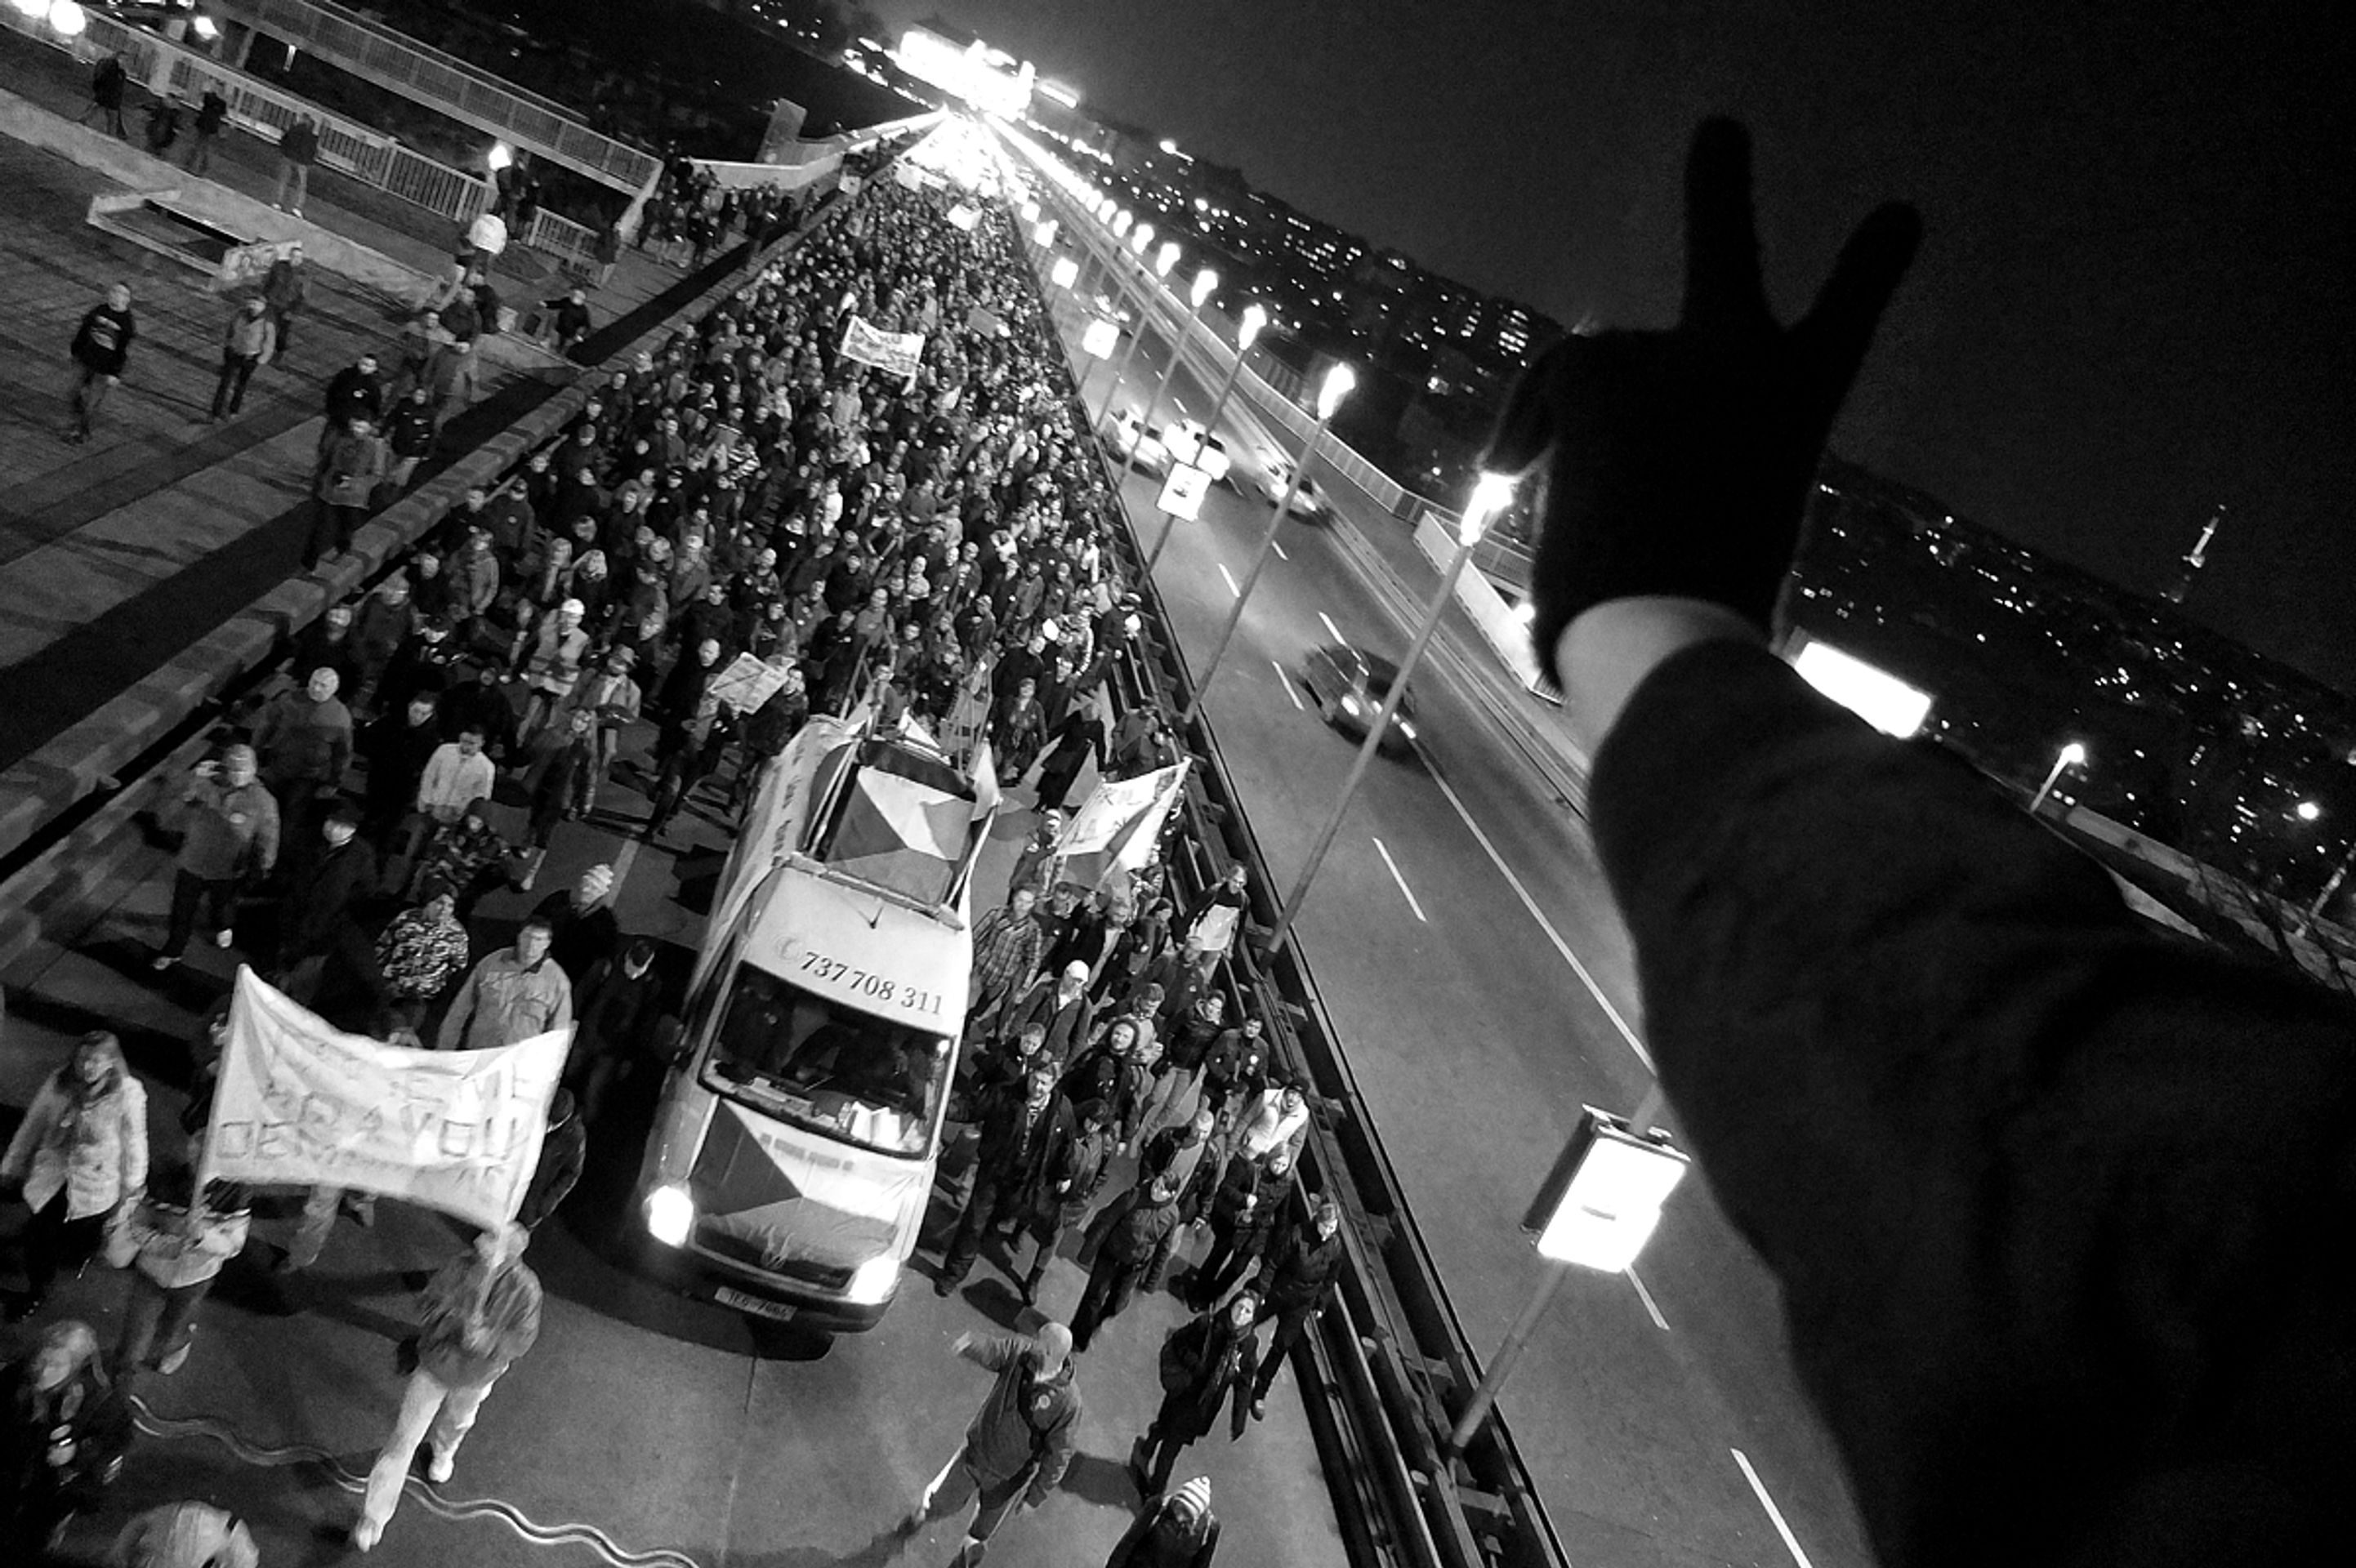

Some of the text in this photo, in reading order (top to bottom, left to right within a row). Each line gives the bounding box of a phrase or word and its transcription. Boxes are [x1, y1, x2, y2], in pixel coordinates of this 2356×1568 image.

[800, 951, 943, 1015] 737 708 311
